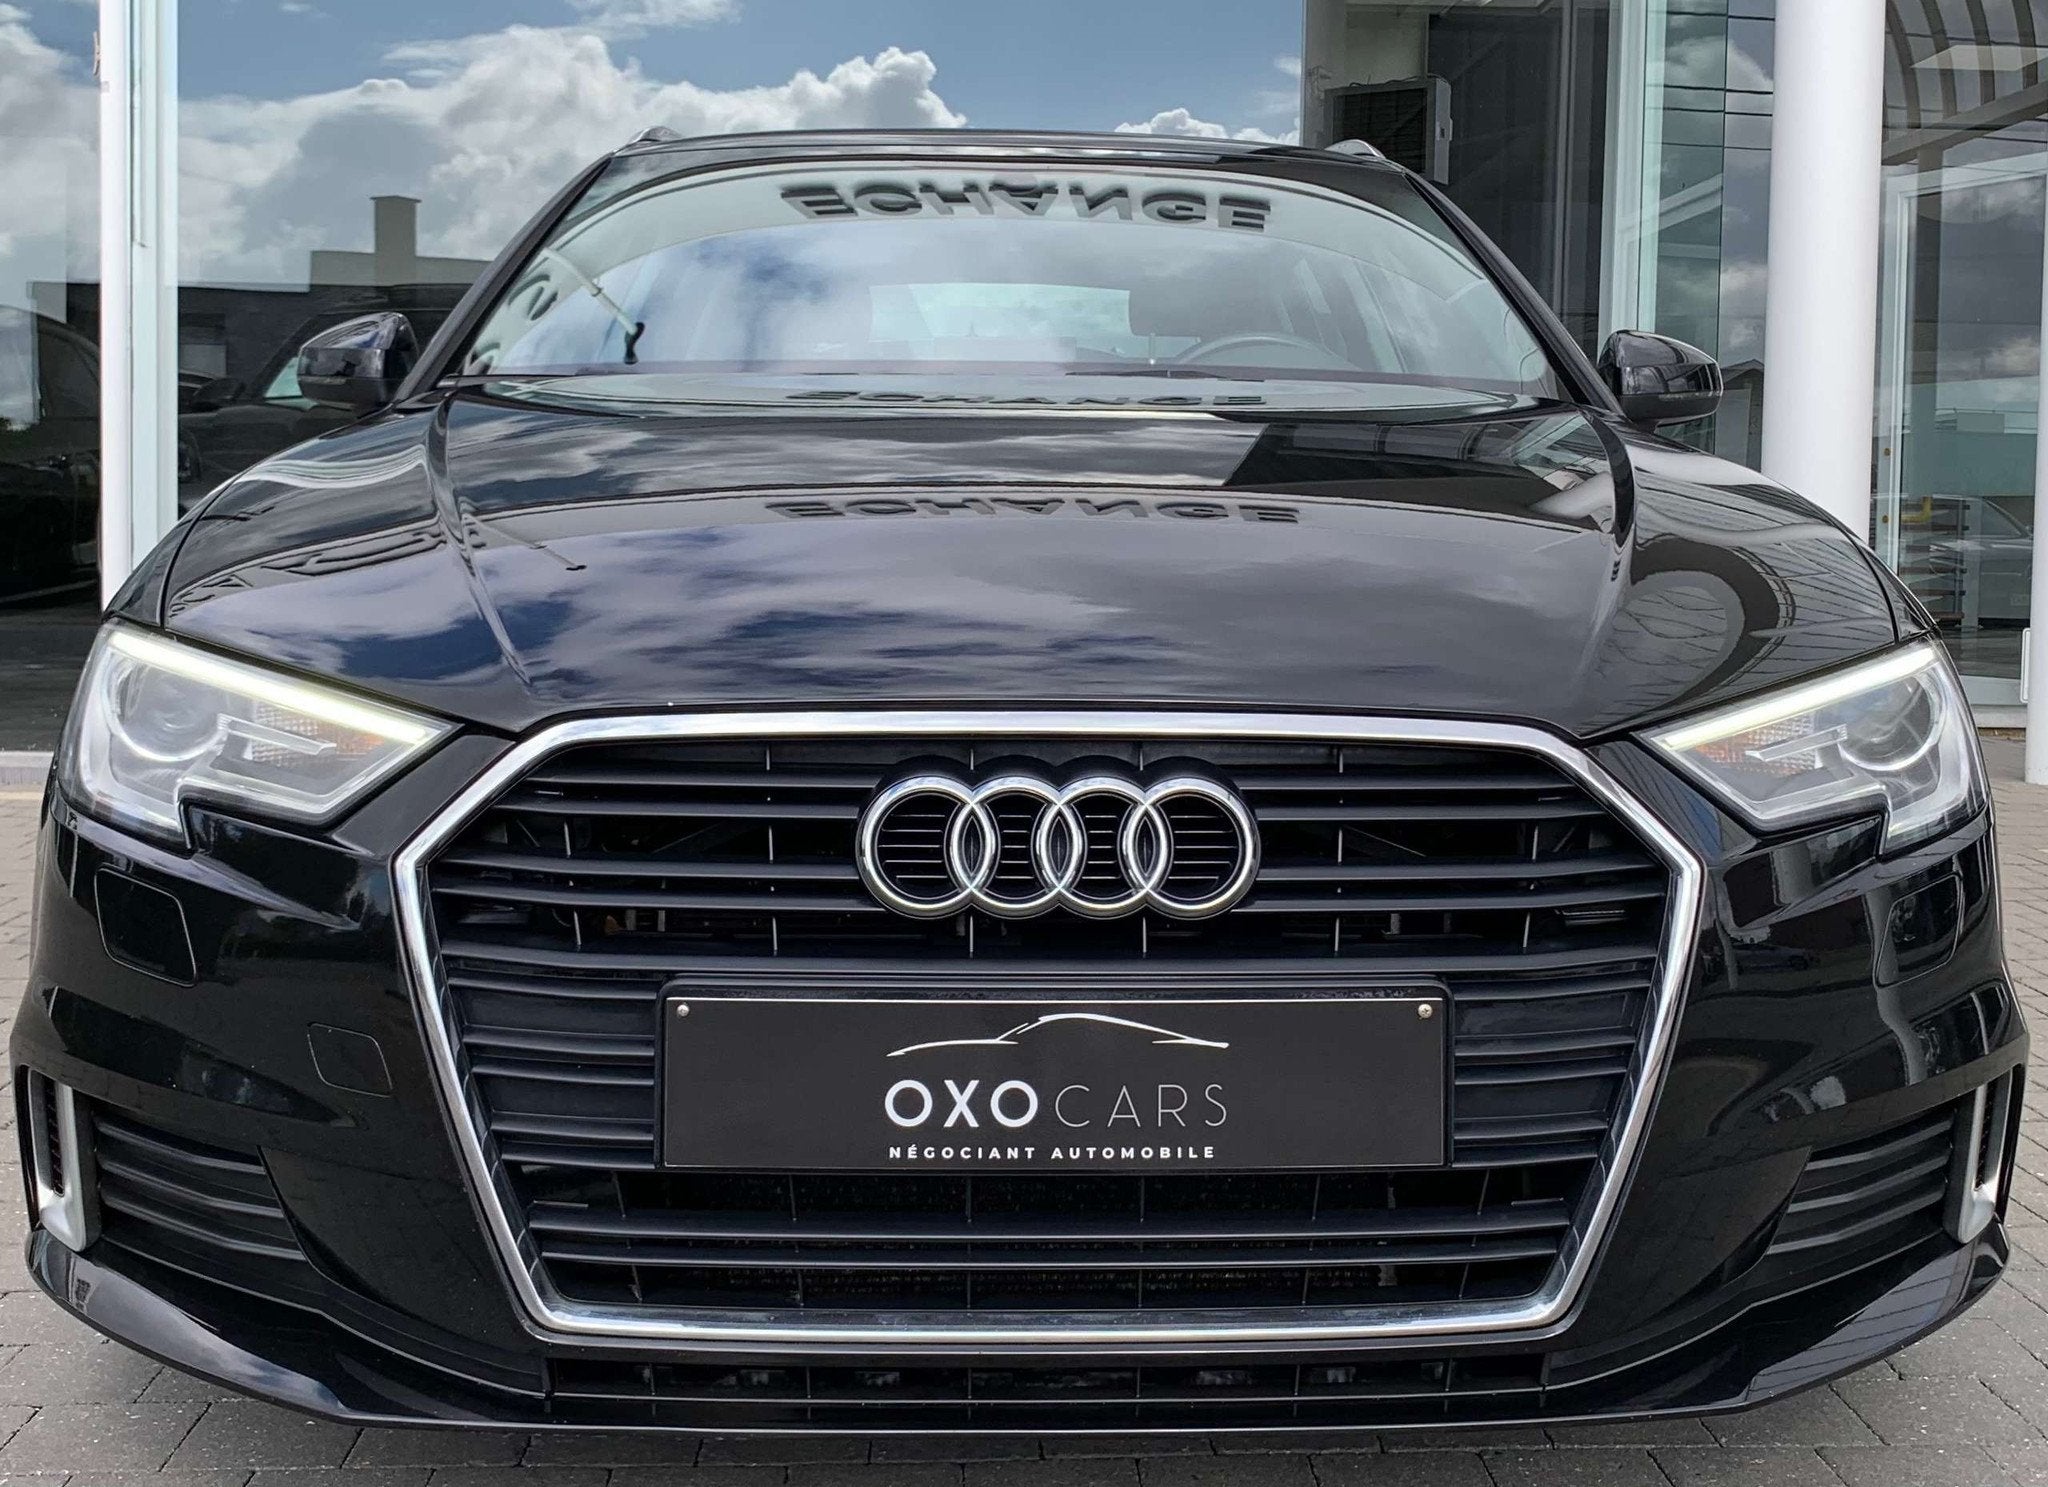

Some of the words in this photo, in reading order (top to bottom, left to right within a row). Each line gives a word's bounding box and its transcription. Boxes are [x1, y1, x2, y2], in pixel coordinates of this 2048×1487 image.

[884, 1079, 1039, 1128] OXO
[1055, 1084, 1227, 1128] CARS
[889, 1144, 1036, 1160] NÉGOCIANT
[1050, 1146, 1215, 1160] AUTOMOBILE
